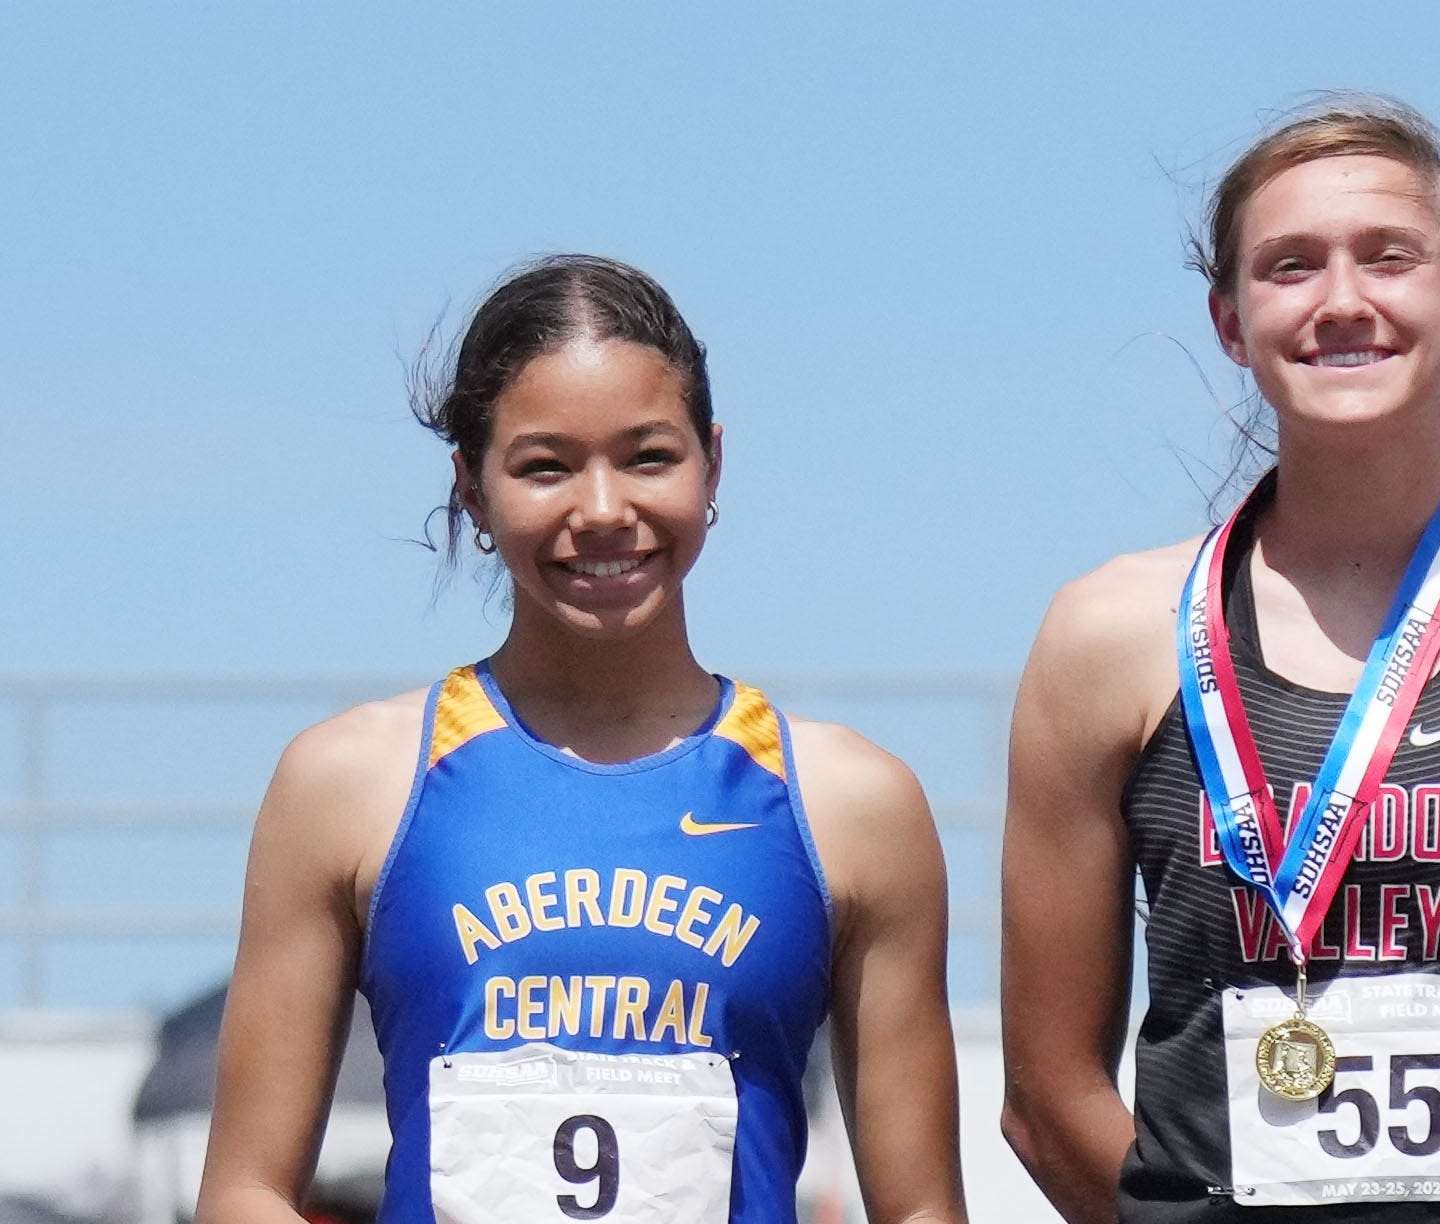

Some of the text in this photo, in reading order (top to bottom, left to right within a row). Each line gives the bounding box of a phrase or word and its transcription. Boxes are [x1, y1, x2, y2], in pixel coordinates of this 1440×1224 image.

[1376, 617, 1427, 707] SDHSAA
[1228, 801, 1270, 887] DHSAA
[1293, 802, 1346, 898] SDHSAA
[452, 868, 760, 967] ABERDEEN
[484, 976, 712, 1047] CENTRAL
[1362, 984, 1413, 1000] STATE
[1380, 1004, 1426, 1018] FIELD
[586, 1067, 682, 1085] FIELD MEET
[552, 1114, 619, 1221] 9
[1322, 1183, 1358, 1197] MAY
[1361, 1181, 1410, 1197] 23-25,
